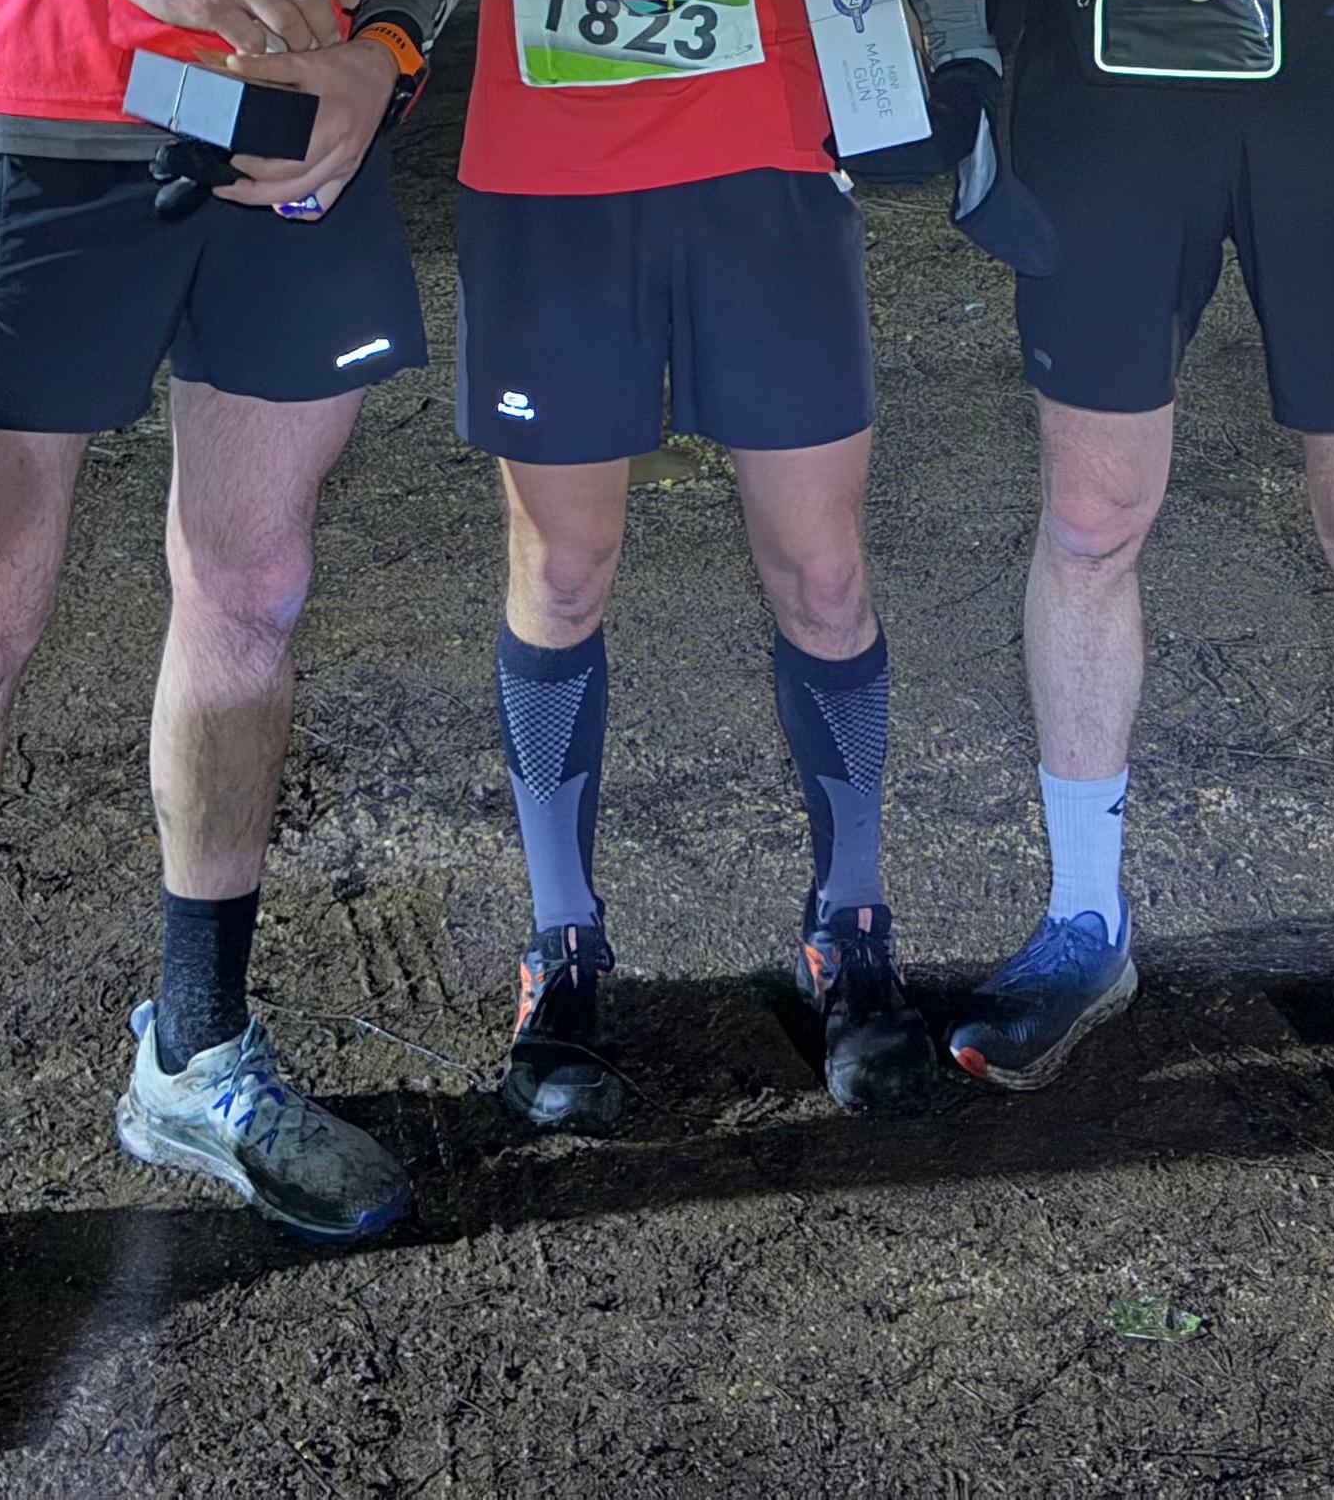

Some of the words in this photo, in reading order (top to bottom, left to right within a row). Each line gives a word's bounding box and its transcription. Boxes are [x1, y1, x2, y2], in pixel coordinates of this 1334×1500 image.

[853, 67, 871, 102] GUN
[865, 42, 893, 118] MASSAGE
[886, 64, 900, 90] MINI
